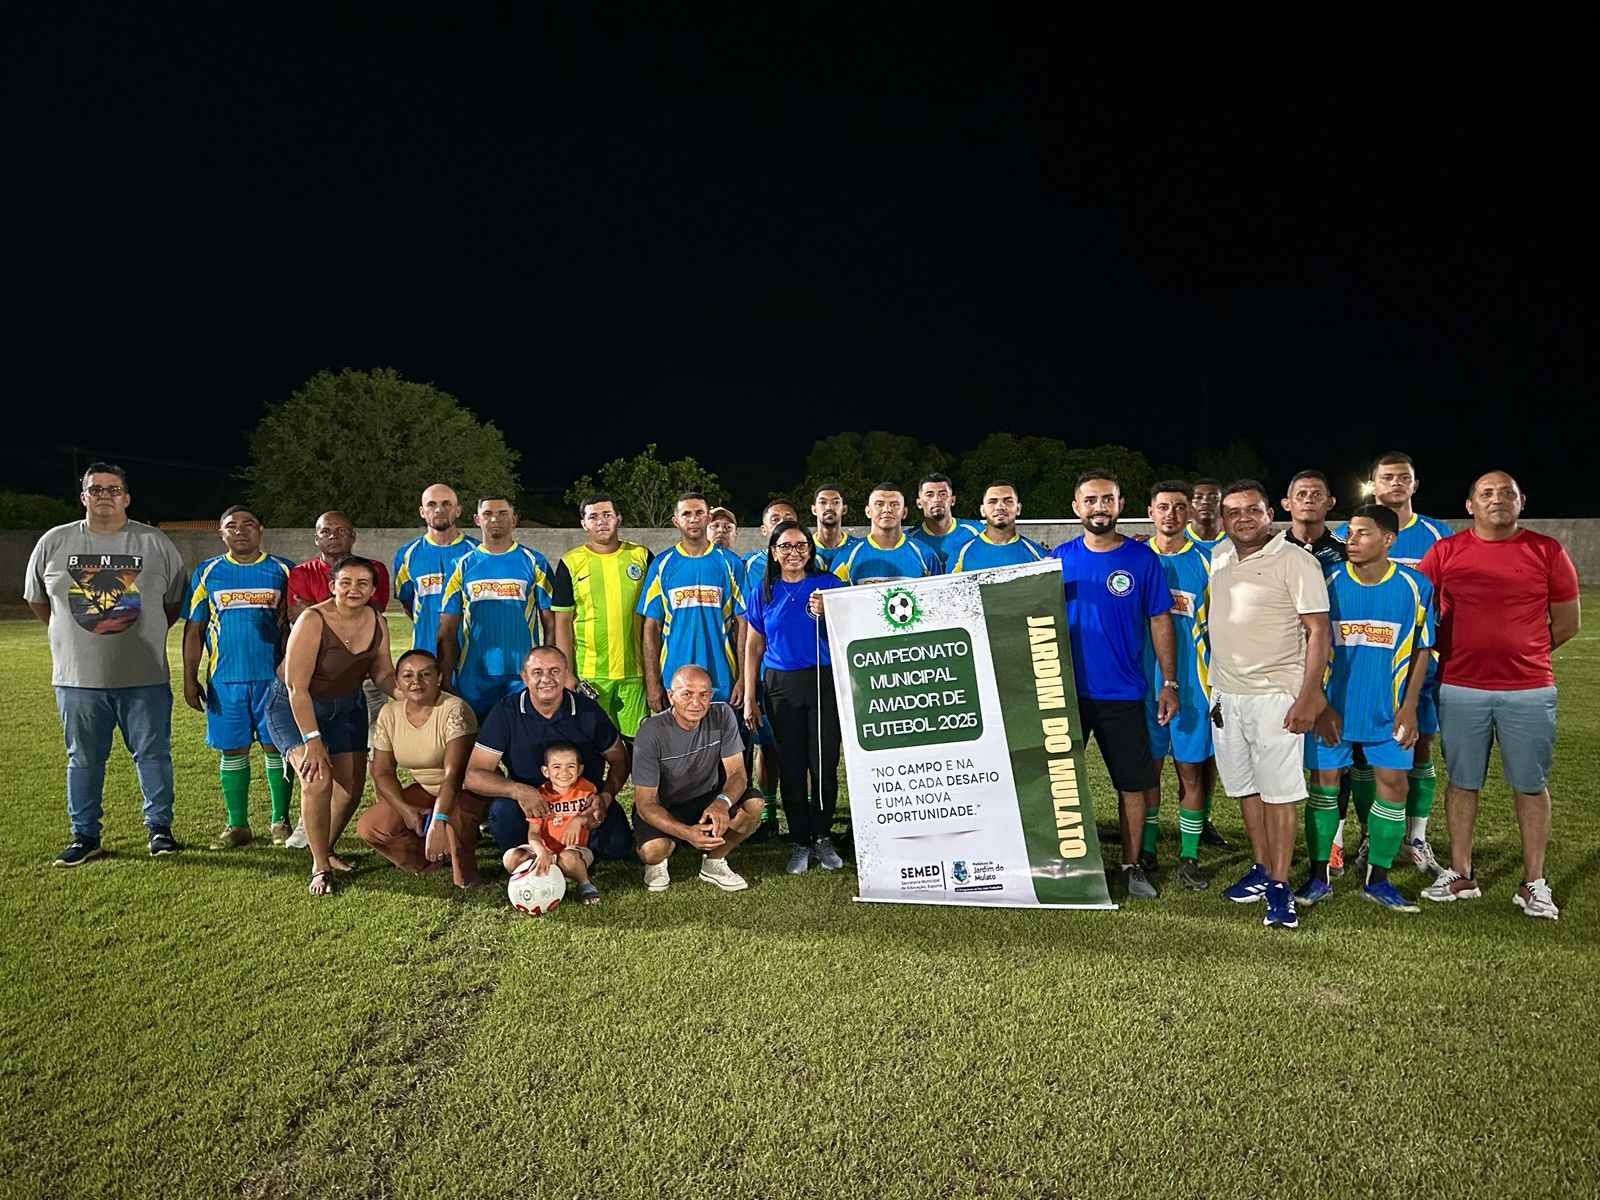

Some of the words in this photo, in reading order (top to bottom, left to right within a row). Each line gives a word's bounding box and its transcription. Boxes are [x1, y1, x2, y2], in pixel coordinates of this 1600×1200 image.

[853, 641, 968, 668] CAMPEONATO
[1026, 615, 1067, 711] JARDIM
[870, 667, 957, 689] MUNICIPAL
[868, 692, 940, 714] AMADOR
[943, 690, 966, 705] DE
[862, 717, 936, 738] FUTEBOL
[937, 712, 978, 730] 2025
[1042, 717, 1072, 753] DO
[898, 761, 942, 775] CAMPO
[946, 759, 953, 771] E
[956, 758, 974, 770] NA
[873, 781, 906, 793] VIDA,
[909, 777, 943, 790] CADA
[947, 771, 999, 786] DESAFIO
[875, 796, 882, 809] É
[886, 795, 913, 808] UMA
[916, 791, 952, 805] NOVA
[1047, 758, 1087, 858] MULATO
[901, 865, 940, 878] SEMED
[974, 866, 995, 874] Jardim
[996, 864, 1004, 872] do
[975, 873, 996, 881] Mulato
